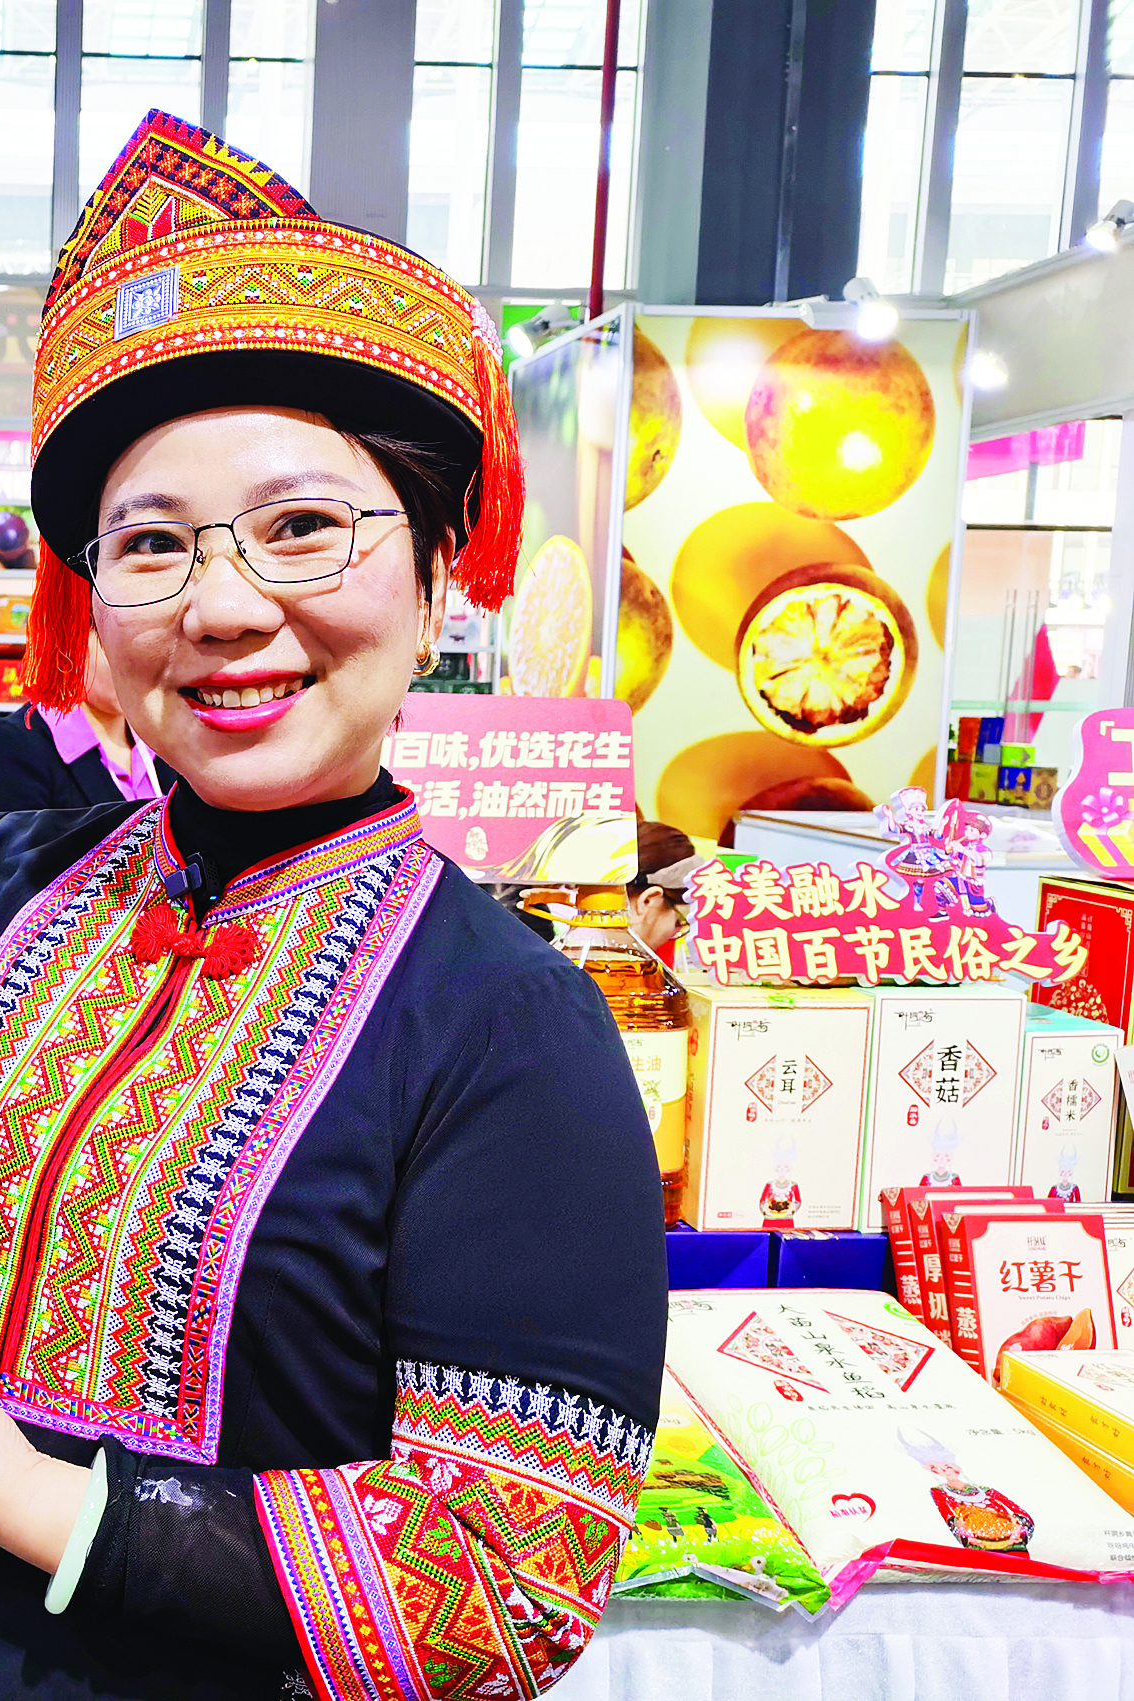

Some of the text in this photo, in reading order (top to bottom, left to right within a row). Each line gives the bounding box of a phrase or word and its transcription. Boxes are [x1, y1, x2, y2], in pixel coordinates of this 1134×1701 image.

[691, 859, 901, 921] 秀美融水
[695, 924, 1090, 985] 中国百节民俗之乡
[780, 1059, 798, 1094] 云耳
[935, 1045, 963, 1104] 香菇
[1065, 1078, 1079, 1121] 香糯米
[999, 1260, 1083, 1293] 红薯干
